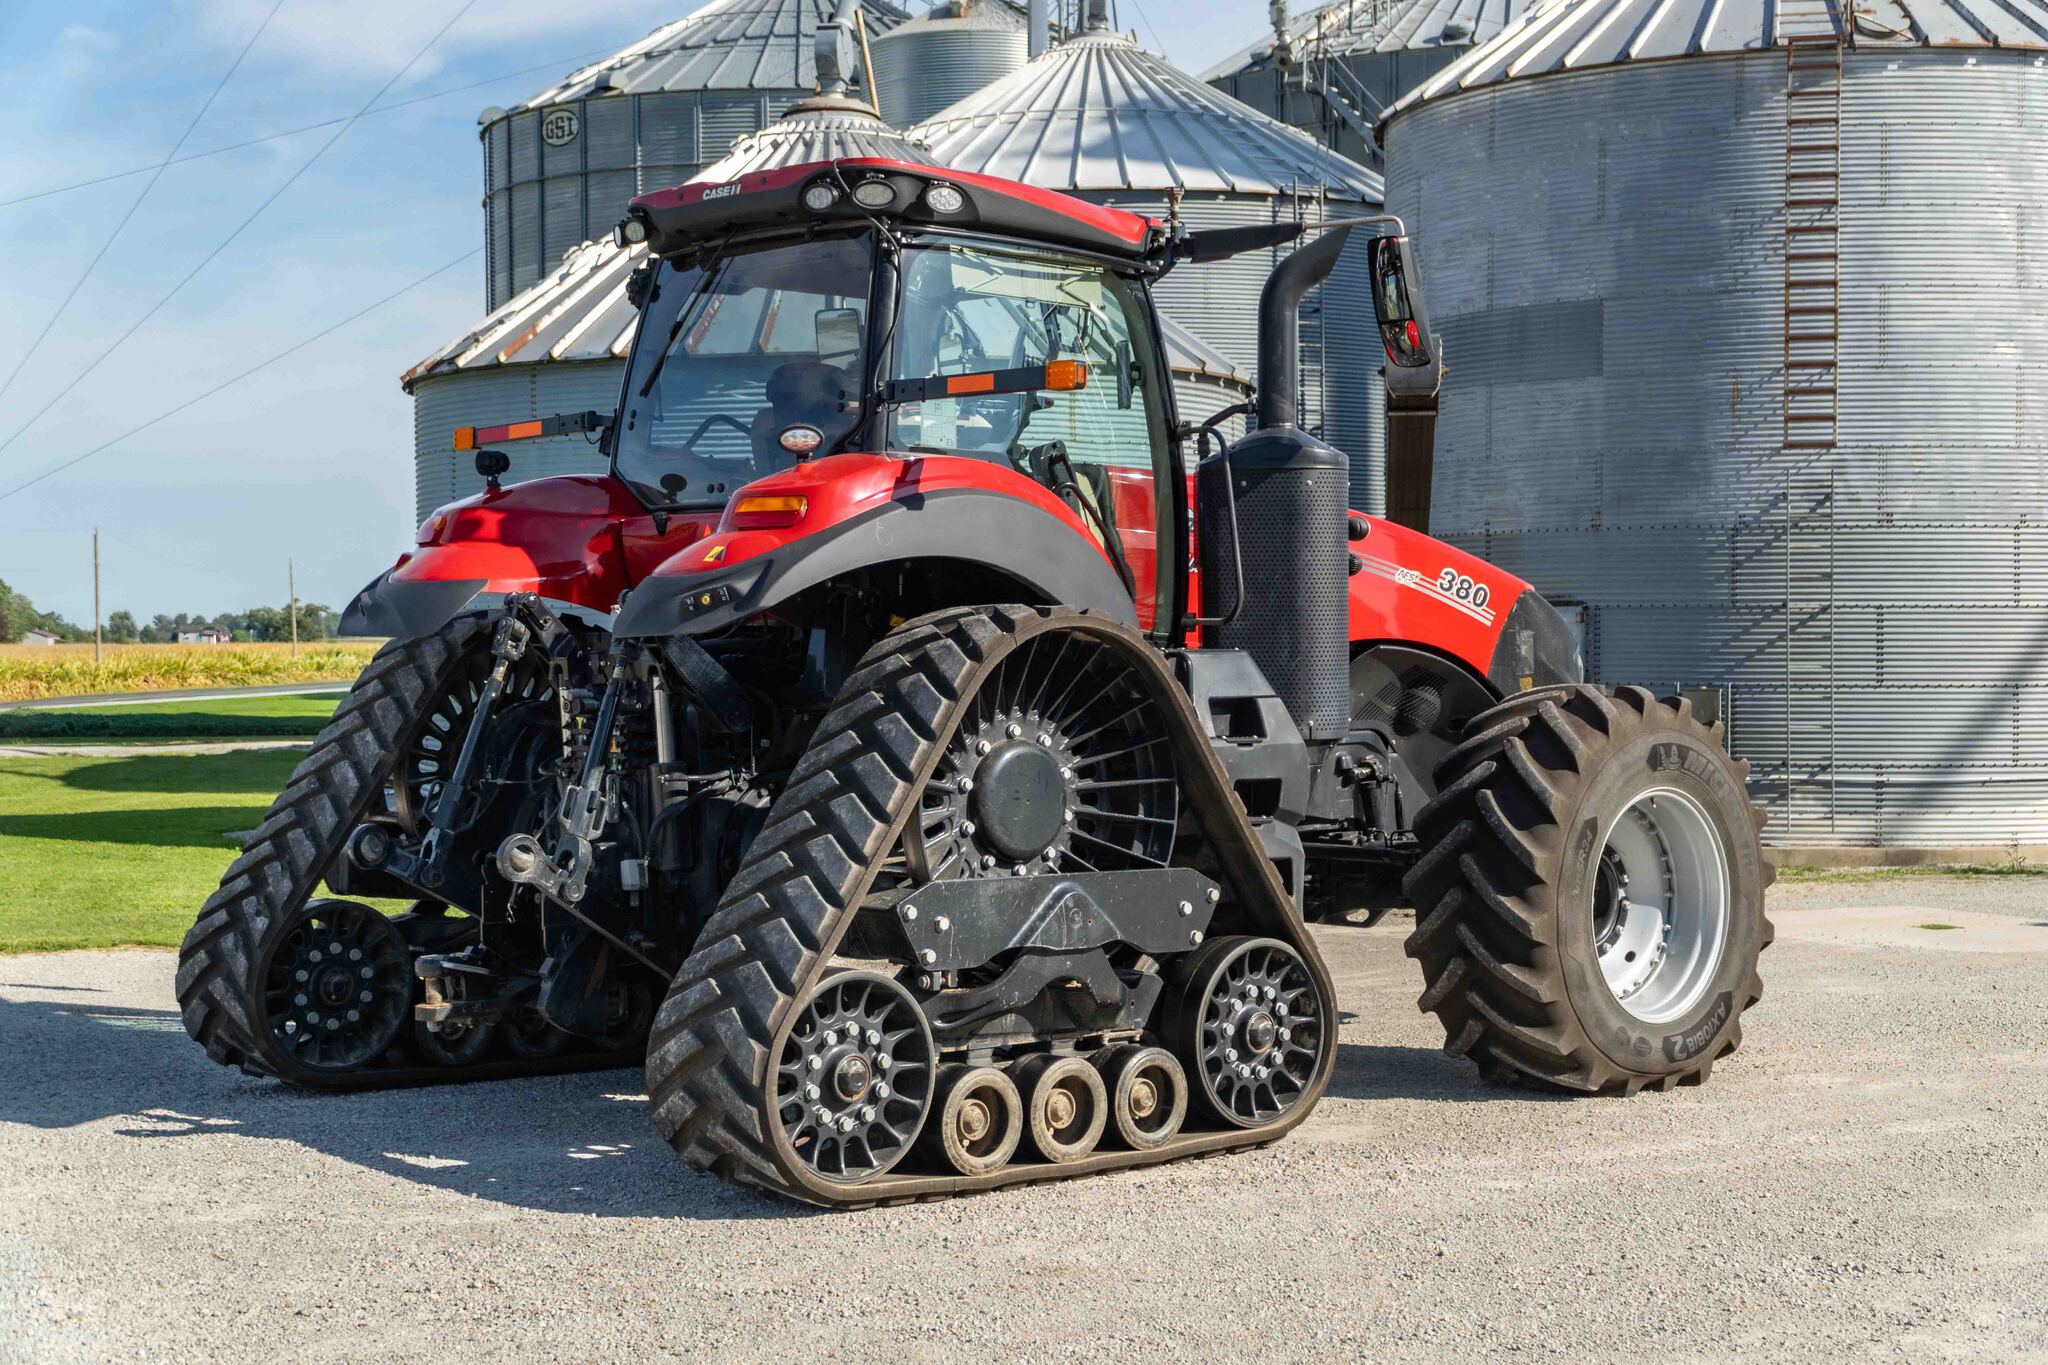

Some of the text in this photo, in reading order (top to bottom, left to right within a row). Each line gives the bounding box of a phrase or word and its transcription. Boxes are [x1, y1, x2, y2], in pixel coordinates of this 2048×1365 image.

[546, 116, 574, 139] GSI
[1438, 568, 1490, 609] 380
[1671, 1001, 1726, 1060] AXIOBIB 2
